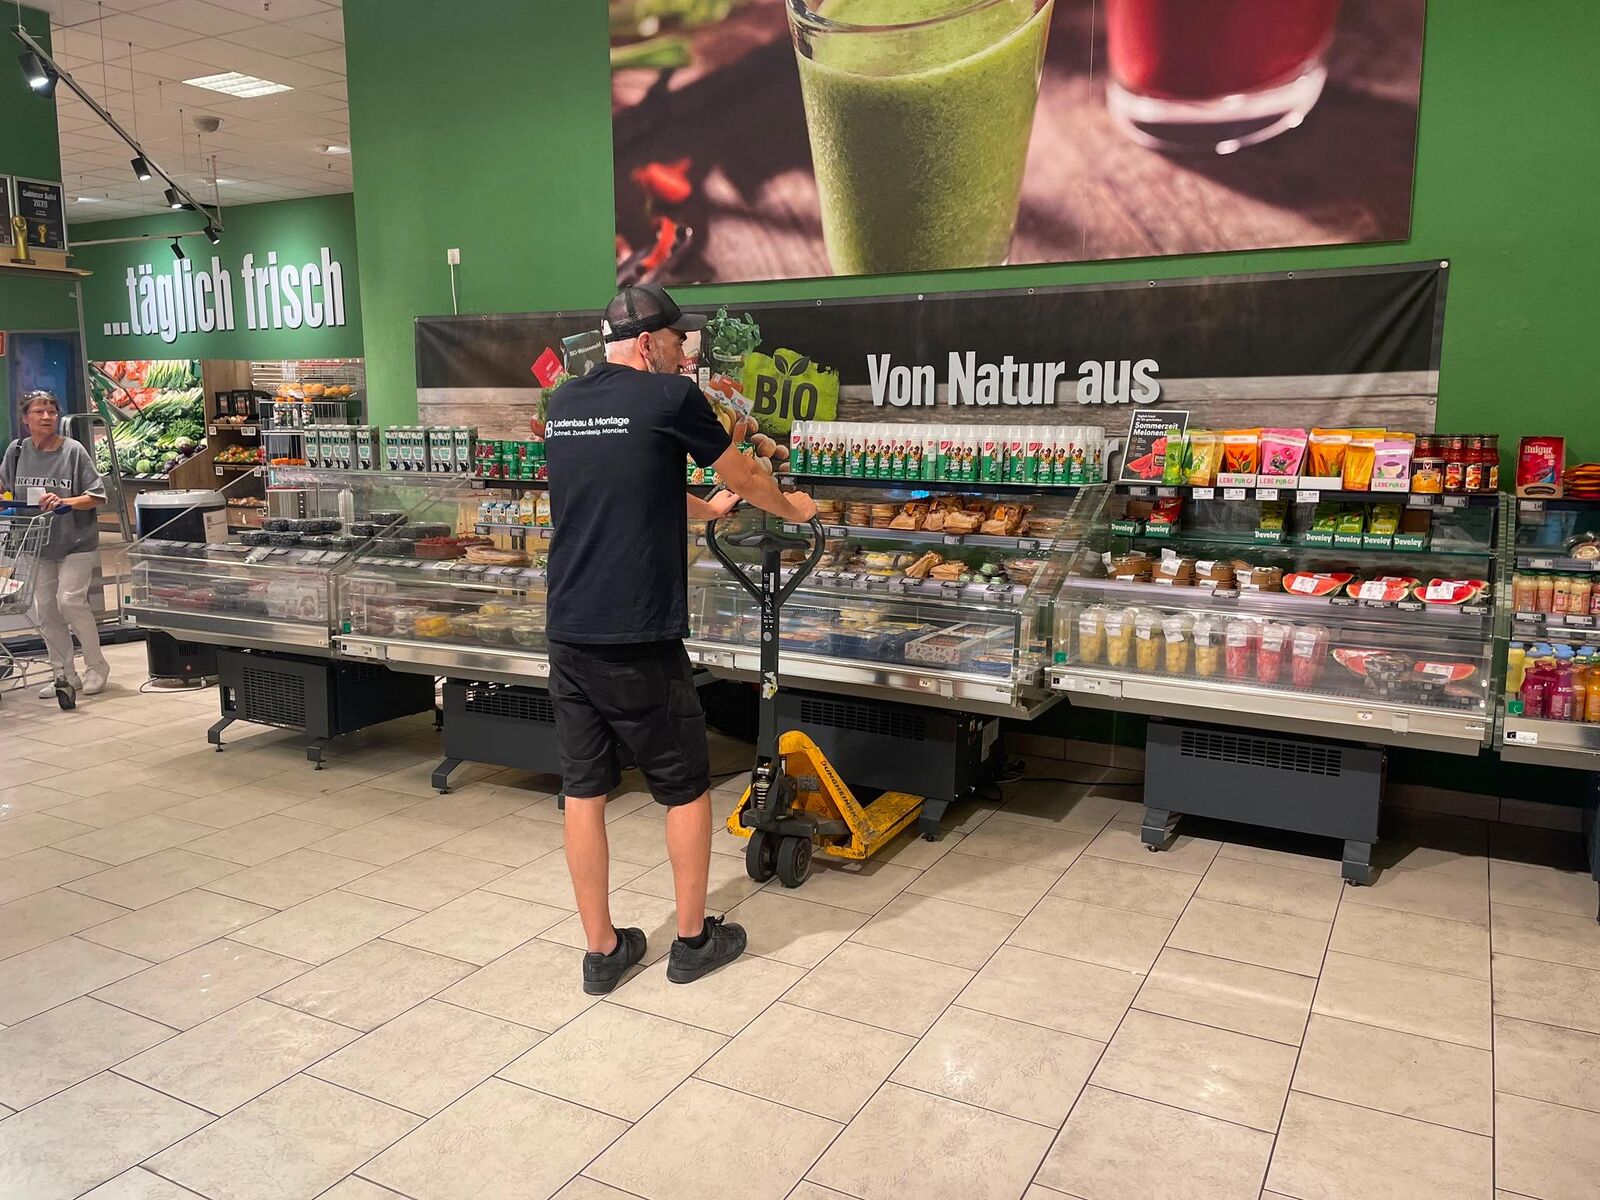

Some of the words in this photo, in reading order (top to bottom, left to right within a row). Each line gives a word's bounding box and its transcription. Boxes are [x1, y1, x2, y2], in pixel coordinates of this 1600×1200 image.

[241, 247, 346, 331] frisch
[866, 353, 936, 407] Von
[948, 350, 1066, 407] Natur
[1077, 358, 1161, 405] aus
[753, 373, 819, 421] BIO
[554, 418, 587, 428] Ladenbau
[587, 417, 594, 427] &
[595, 416, 630, 426] Montage
[1134, 422, 1179, 430] Sommerzeit
[1524, 445, 1553, 455] Bulgur
[1255, 531, 1281, 541] Develey
[1306, 533, 1332, 543] Develey
[1334, 534, 1361, 544] Develey
[1363, 536, 1391, 546] Develey
[1394, 537, 1422, 548] Develey
